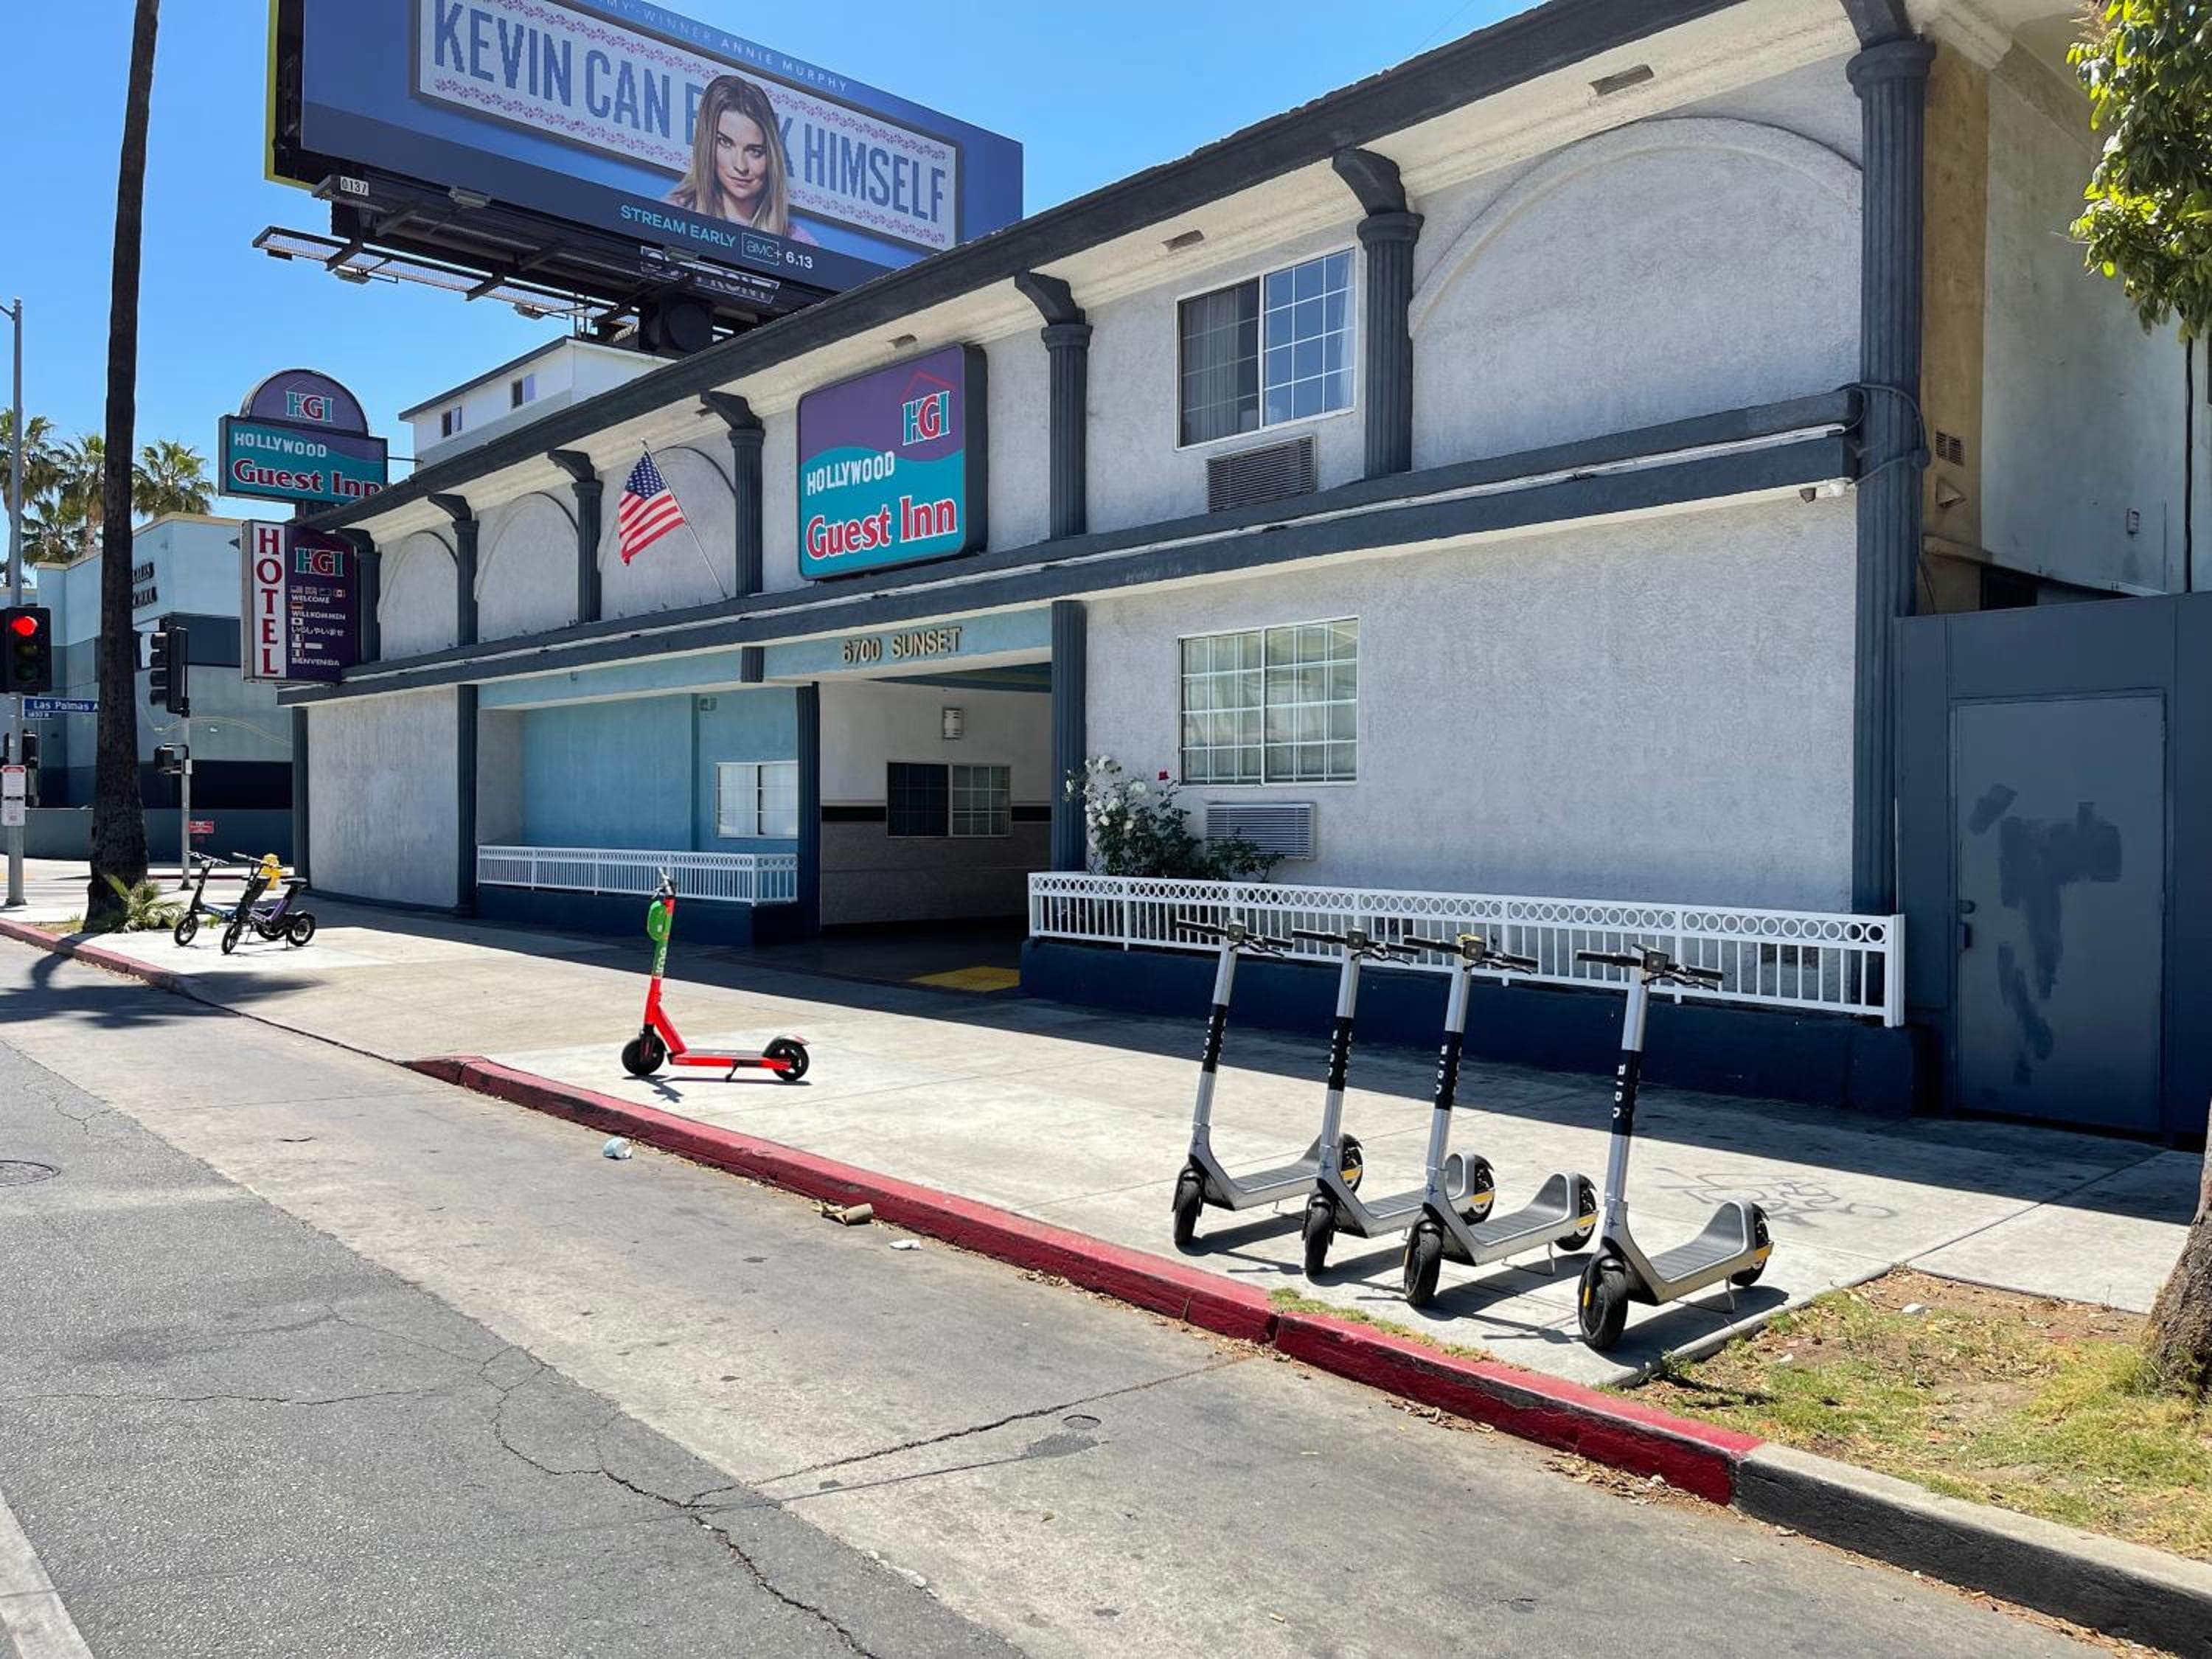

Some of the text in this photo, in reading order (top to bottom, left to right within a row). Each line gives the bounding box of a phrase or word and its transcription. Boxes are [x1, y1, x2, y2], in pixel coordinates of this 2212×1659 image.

[606, 0, 847, 91] MY-WINNER ANNIE MURPHY
[434, 1, 946, 223] KEVIN CAN FK HIMSELF
[341, 178, 366, 193] 0137
[620, 205, 686, 234] STREAM
[690, 224, 736, 248] EARLY
[785, 251, 814, 269] 6.13
[285, 392, 333, 422] HGI
[902, 389, 950, 446] HGI
[234, 431, 327, 459] HOLLYWOOD
[232, 459, 383, 498] Guest Inn
[807, 450, 895, 497] HOLLYWOOD
[806, 495, 959, 561] Guest Inn
[295, 548, 344, 577] HGI
[256, 527, 283, 675] HOTEL
[291, 594, 330, 605] WELCOME
[842, 627, 962, 664] 6700 SUNSET
[33, 700, 51, 710] Las
[55, 701, 89, 712] Palmas
